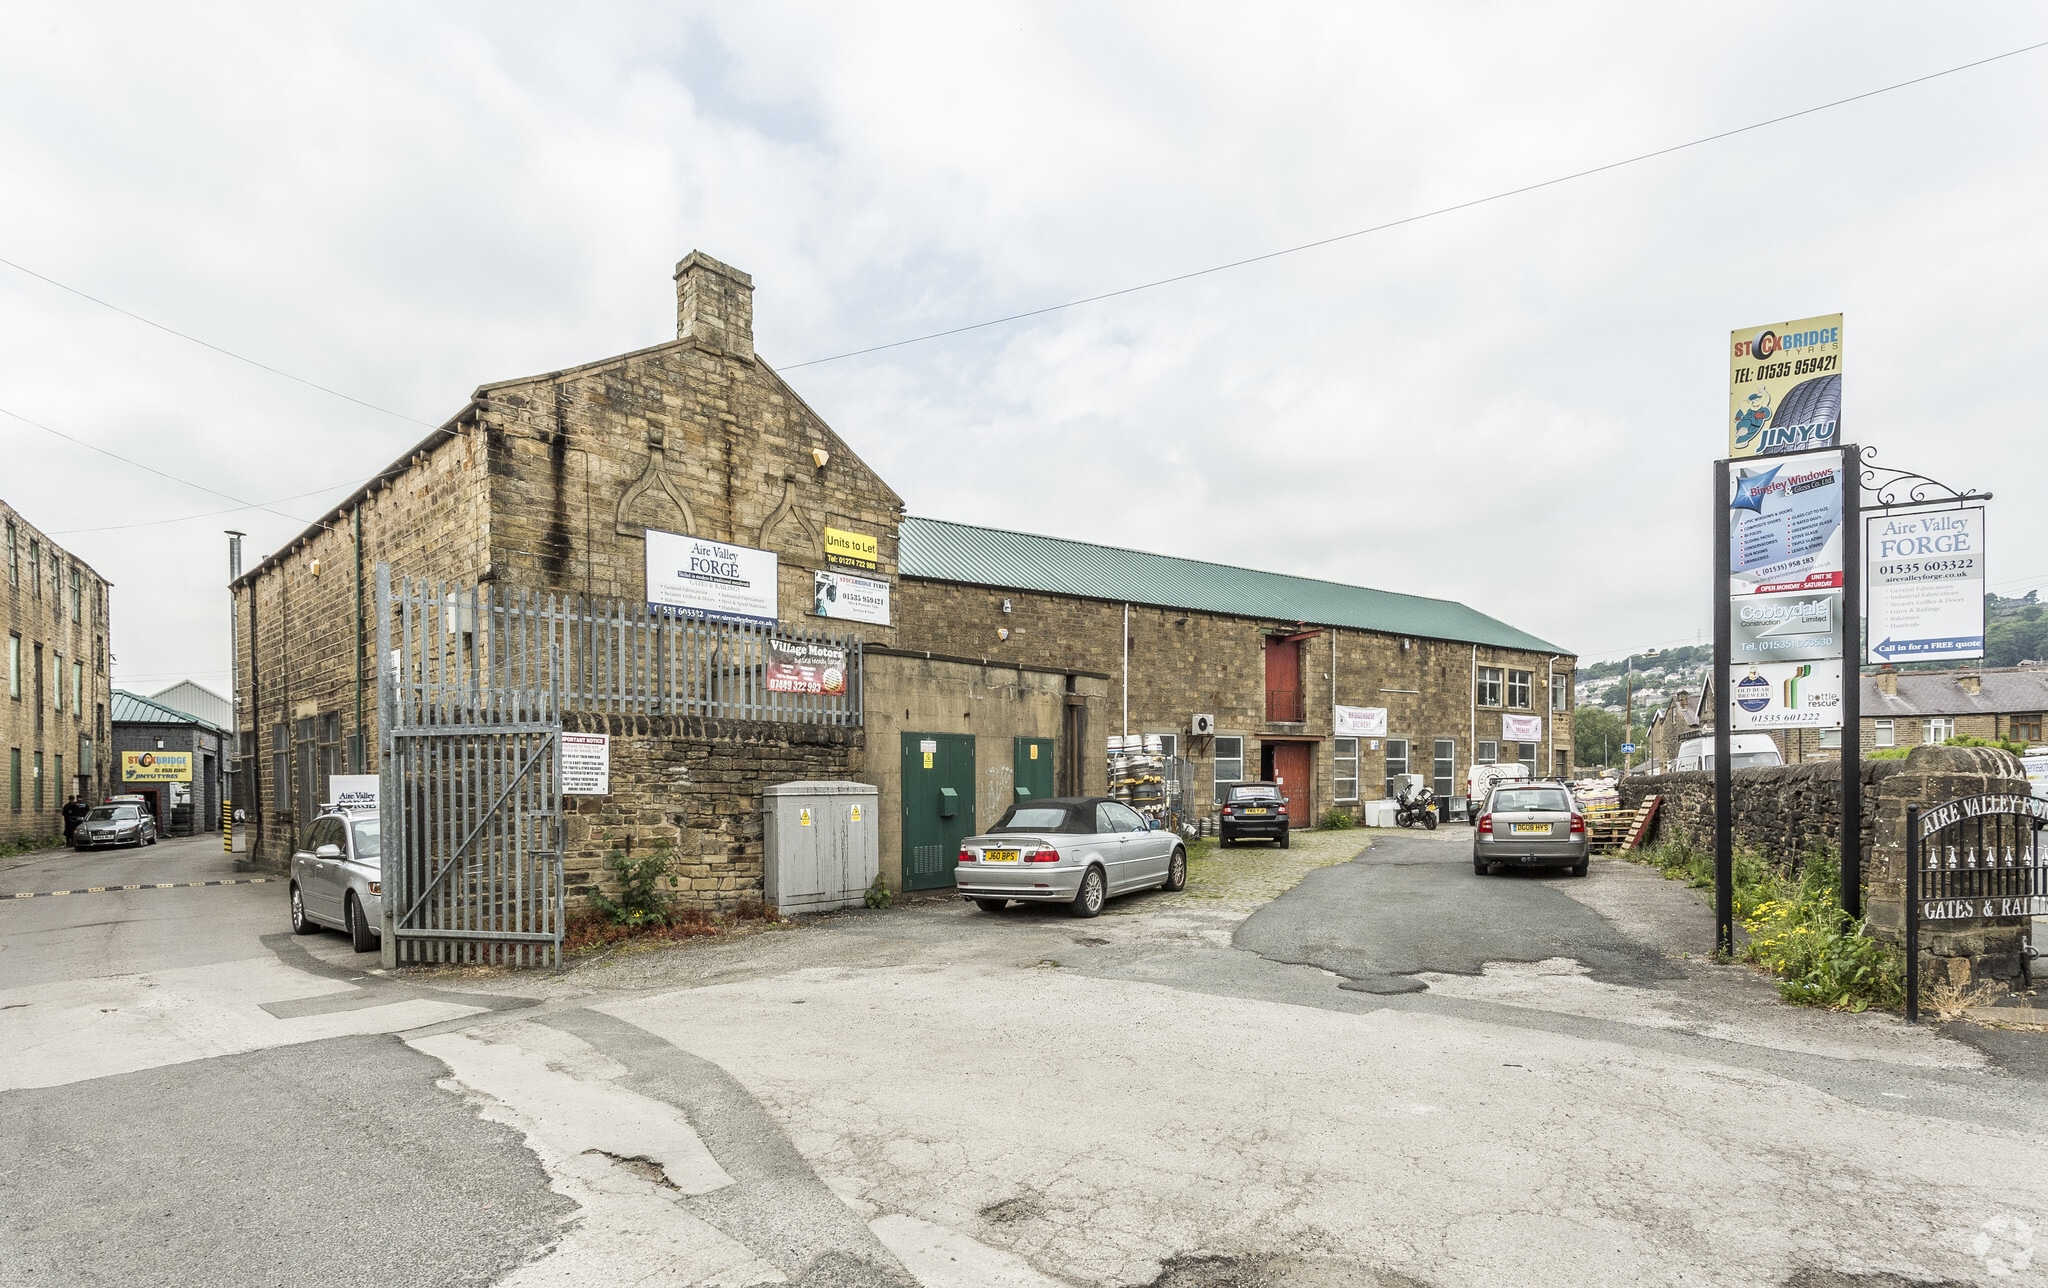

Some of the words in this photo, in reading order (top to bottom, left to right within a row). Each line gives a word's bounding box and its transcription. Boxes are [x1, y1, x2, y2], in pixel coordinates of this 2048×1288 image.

[1735, 327, 1838, 360] STOCKBRIDGE
[1785, 343, 1838, 357] TYRES
[1735, 368, 1753, 384] TEL:
[1757, 362, 1792, 380] 01535
[1795, 355, 1838, 376] 959421
[1756, 422, 1835, 454] JINYU
[1750, 480, 1786, 496] Bingley
[1788, 468, 1834, 486] Windows
[1785, 487, 1793, 496] &
[1794, 484, 1810, 492] Glass
[1744, 522, 1767, 531] COMPOSITE
[1792, 523, 1818, 533] GREENHOUSE
[1882, 521, 1916, 535] Aire
[1920, 517, 1968, 533] Valley
[828, 536, 850, 548] Units
[853, 540, 860, 550] to
[862, 542, 875, 554] Let
[1744, 539, 1778, 551] CONSERVATORIES
[1880, 533, 1970, 557] FORGE
[691, 542, 711, 556] Aire
[713, 547, 738, 562] Valley
[827, 554, 838, 563] Tel:
[1744, 555, 1769, 564] ORANGERIES
[1762, 563, 1787, 575] (01535)
[1788, 560, 1800, 570] 958
[1802, 557, 1814, 566] 183
[690, 557, 740, 578] FORGE
[1880, 562, 1919, 575] 01535
[1924, 559, 1973, 572] 603322
[840, 577, 871, 587] STOCKBRIDGE
[1885, 571, 1968, 583] airevalleyforge.co.uk
[714, 584, 740, 592] RAILINGS
[843, 593, 861, 601] 01535
[863, 596, 883, 605] 959421
[1740, 600, 1827, 622] Cobbydale
[771, 640, 807, 656] Village
[808, 645, 843, 658] Motors
[1740, 642, 1757, 651] Tel.
[1759, 640, 1794, 651] (01535)
[1908, 642, 1922, 650] for
[1956, 640, 1981, 650] quote
[770, 679, 792, 690] 07449
[793, 681, 807, 691] 322
[807, 682, 821, 692] 993
[1808, 692, 1837, 700] bottle
[1751, 714, 1780, 722] 01535
[128, 753, 187, 767] STOCKBRIDGE
[354, 792, 375, 801] Valley
[1924, 804, 1960, 836] AIRE
[1963, 794, 2017, 818] VALLEY
[1002, 852, 1014, 860] BPS
[1925, 899, 1974, 920] GATES
[1984, 900, 1993, 918] &
